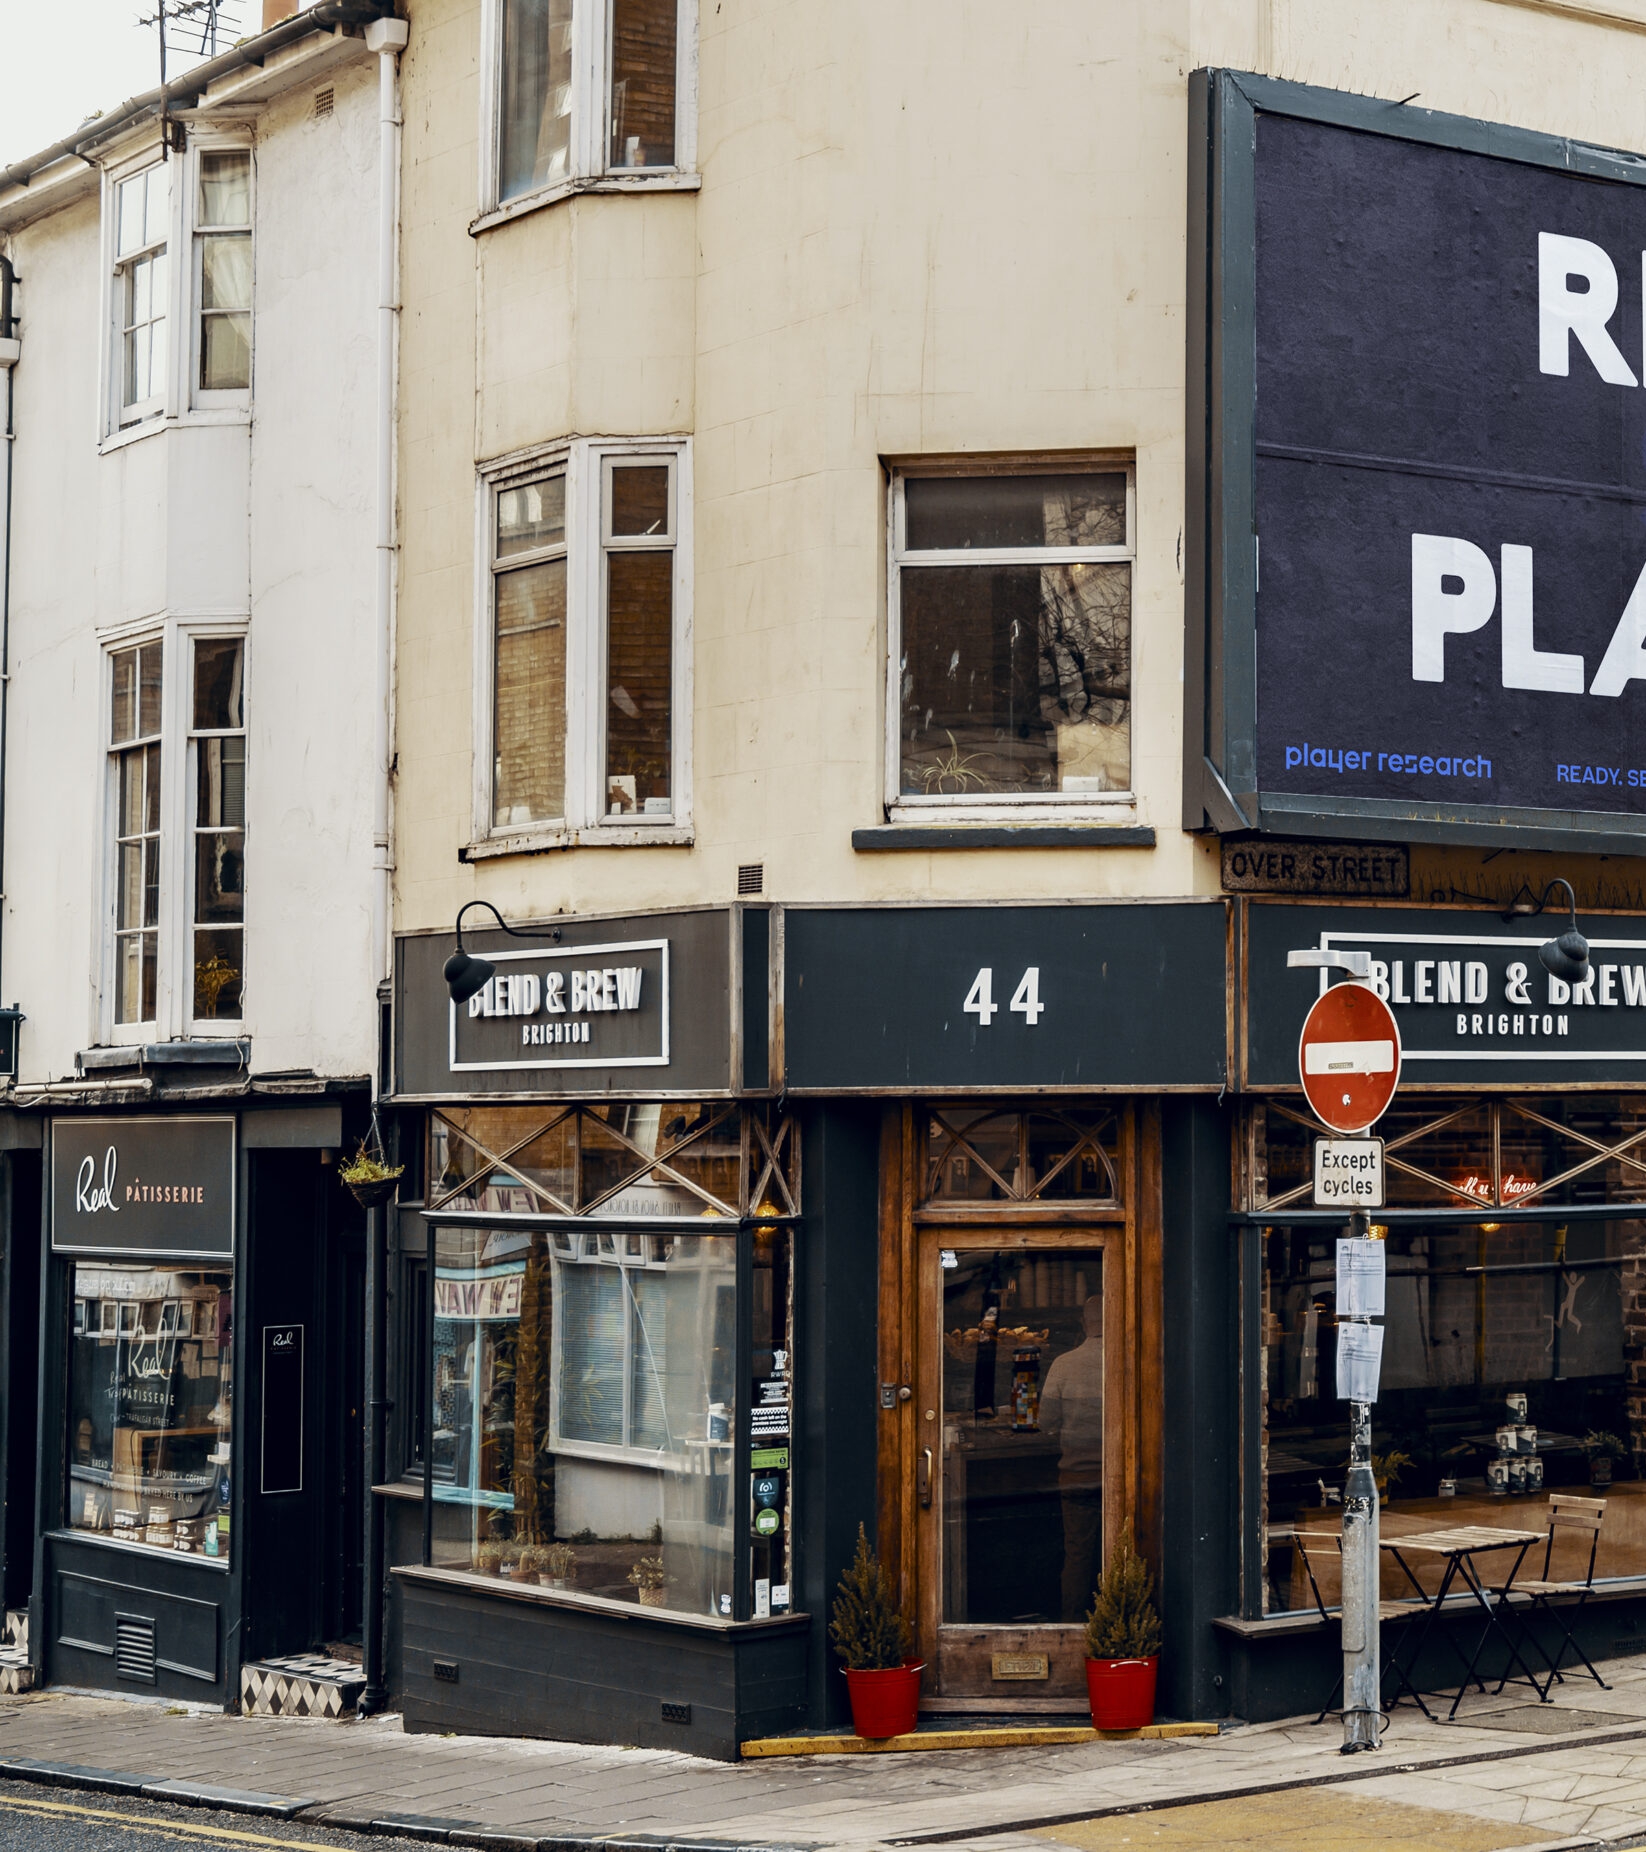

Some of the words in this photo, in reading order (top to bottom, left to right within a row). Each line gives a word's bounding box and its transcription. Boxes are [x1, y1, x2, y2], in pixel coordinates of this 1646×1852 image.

[1285, 742, 1372, 774] player
[1378, 752, 1492, 778] research
[1557, 764, 1623, 787] READY.
[1231, 852, 1296, 880] OVER
[1311, 855, 1400, 883] STREET
[469, 973, 541, 1018] BLEND
[545, 971, 567, 1013] &
[571, 966, 643, 1013] BREW
[963, 966, 1045, 1026] 44
[1370, 959, 1489, 1004] BLEND
[1505, 961, 1532, 1005] &
[522, 1021, 590, 1045] BRIGHTON
[1456, 1013, 1569, 1036] BRIGHTON
[1322, 1149, 1376, 1172] Except
[76, 1145, 121, 1212] Real
[125, 1177, 204, 1203] PÂTISSERIE
[1323, 1176, 1373, 1196] cycles
[128, 1318, 171, 1380] Real
[273, 1331, 294, 1346] Real
